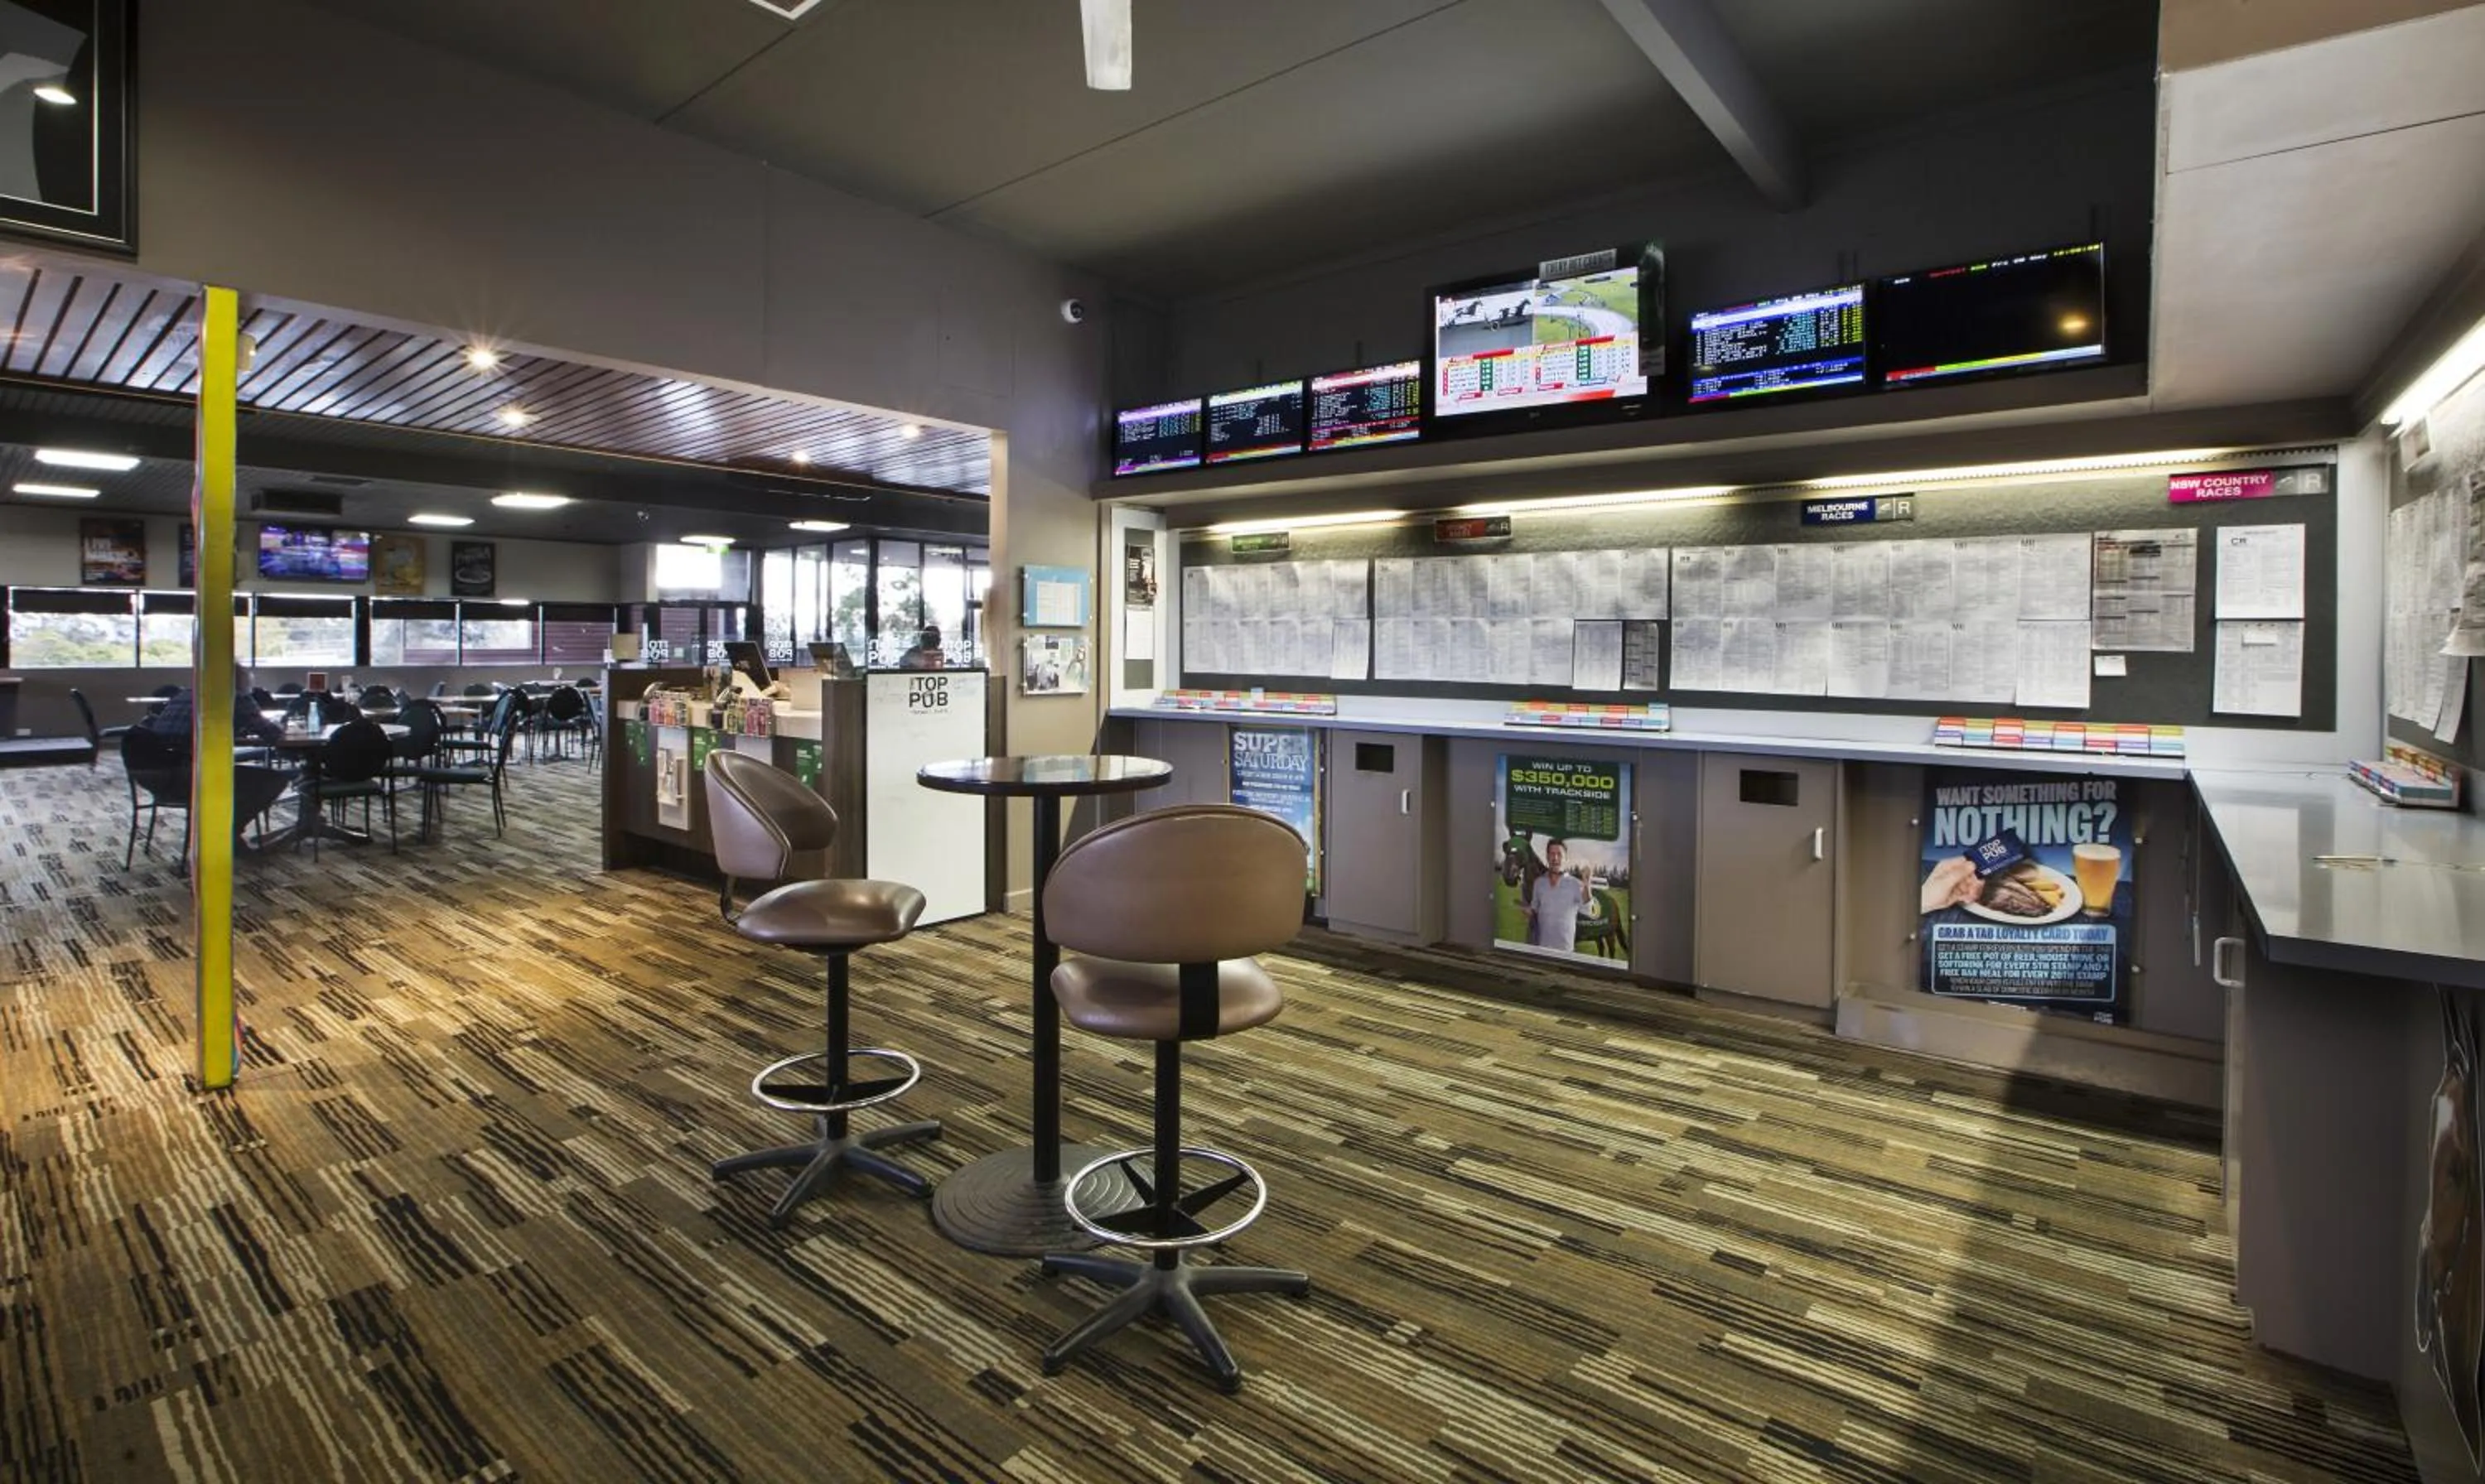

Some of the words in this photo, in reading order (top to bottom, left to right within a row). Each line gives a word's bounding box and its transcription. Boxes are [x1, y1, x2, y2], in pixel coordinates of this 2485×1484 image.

[2170, 479, 2201, 490] NSW
[2203, 475, 2269, 489] COUNTRY
[2196, 487, 2242, 498] RACES
[1807, 501, 1869, 513] MELBOURNE
[1821, 512, 1855, 521] RACES
[914, 677, 948, 691] TOP
[910, 691, 948, 708] PUB
[1235, 750, 1309, 772] SATURDAY
[1532, 762, 1554, 771] WIN
[1557, 763, 1573, 771] UP
[1576, 764, 1592, 773] TO
[1511, 768, 1614, 789] $350,000
[1514, 784, 1542, 794] WITH
[1546, 788, 1610, 798] TRACKSIDE
[1936, 787, 1981, 805] WANT
[1982, 783, 2079, 804] SOMETHING
[2082, 780, 2117, 801] FOR
[1934, 802, 2117, 846] NOTHING?
[1937, 927, 1965, 938] GRAB
[1966, 927, 1975, 938] A
[1976, 928, 1994, 938] TAB
[1996, 928, 2040, 939] LOYALTY
[2041, 928, 2070, 940] CARD
[2073, 928, 2108, 941] TODAY
[1937, 952, 1952, 960] GET
[1954, 952, 1961, 960] A
